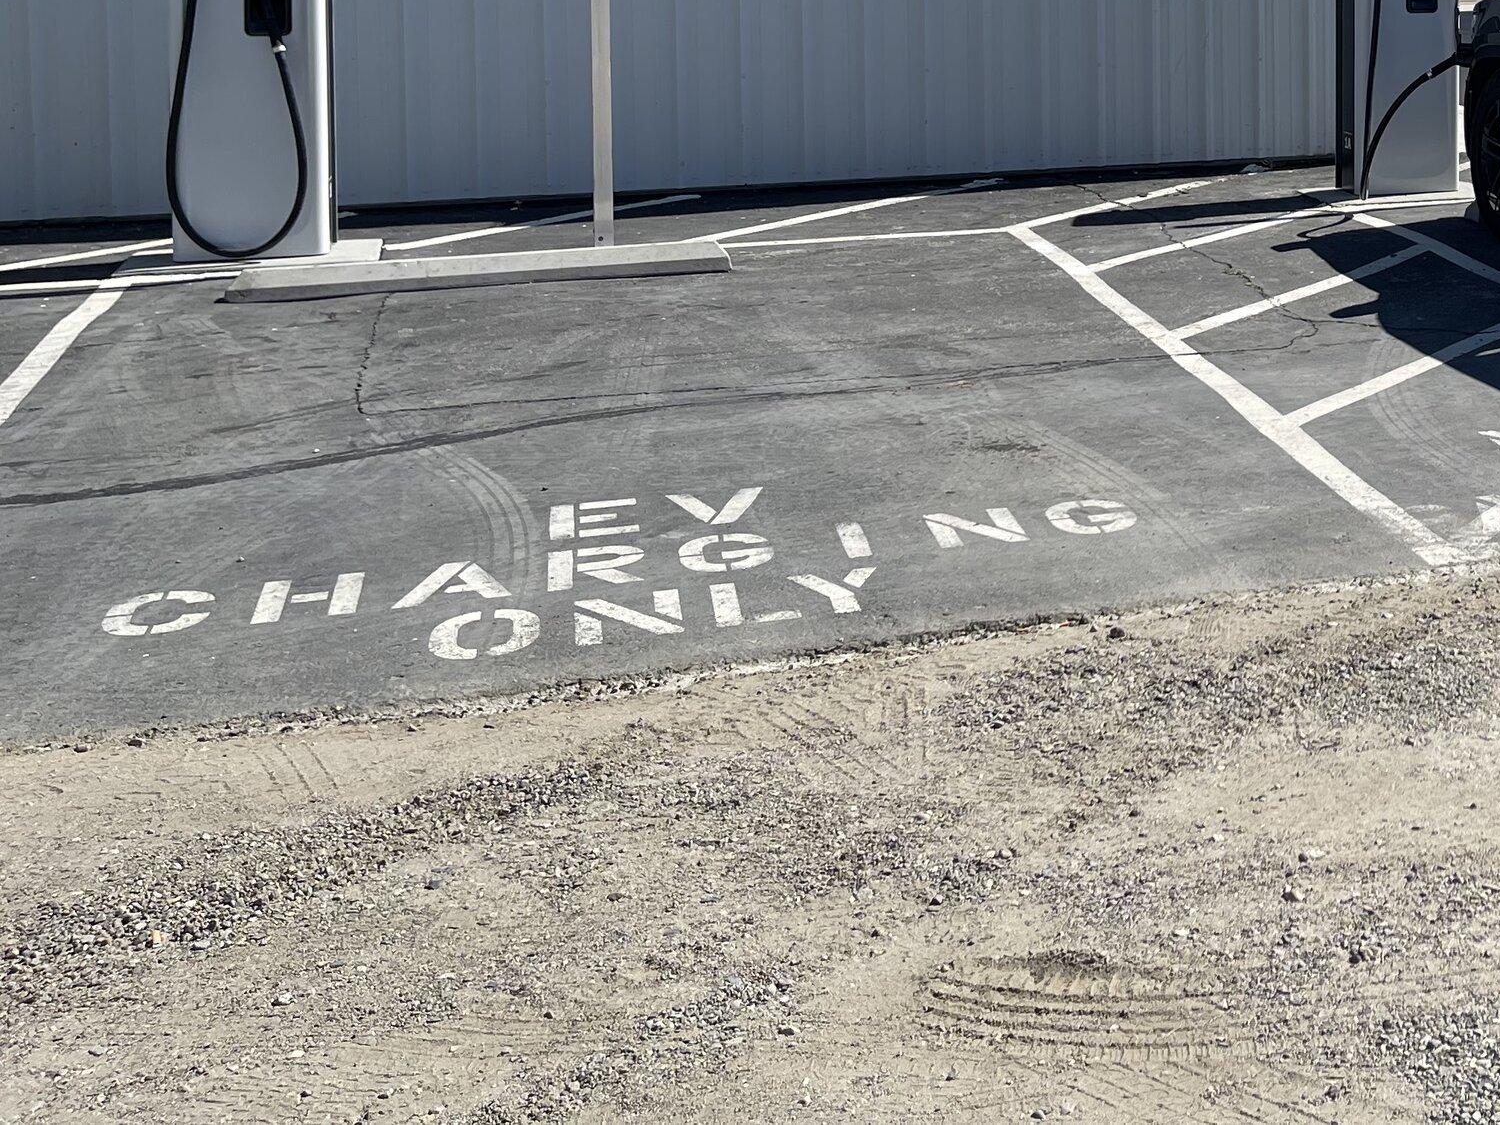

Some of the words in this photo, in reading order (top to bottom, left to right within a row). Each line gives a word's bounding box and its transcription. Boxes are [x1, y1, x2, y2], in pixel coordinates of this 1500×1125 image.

[549, 486, 763, 540] EV
[101, 499, 1138, 637] CHARGING
[428, 567, 877, 660] ONLY
